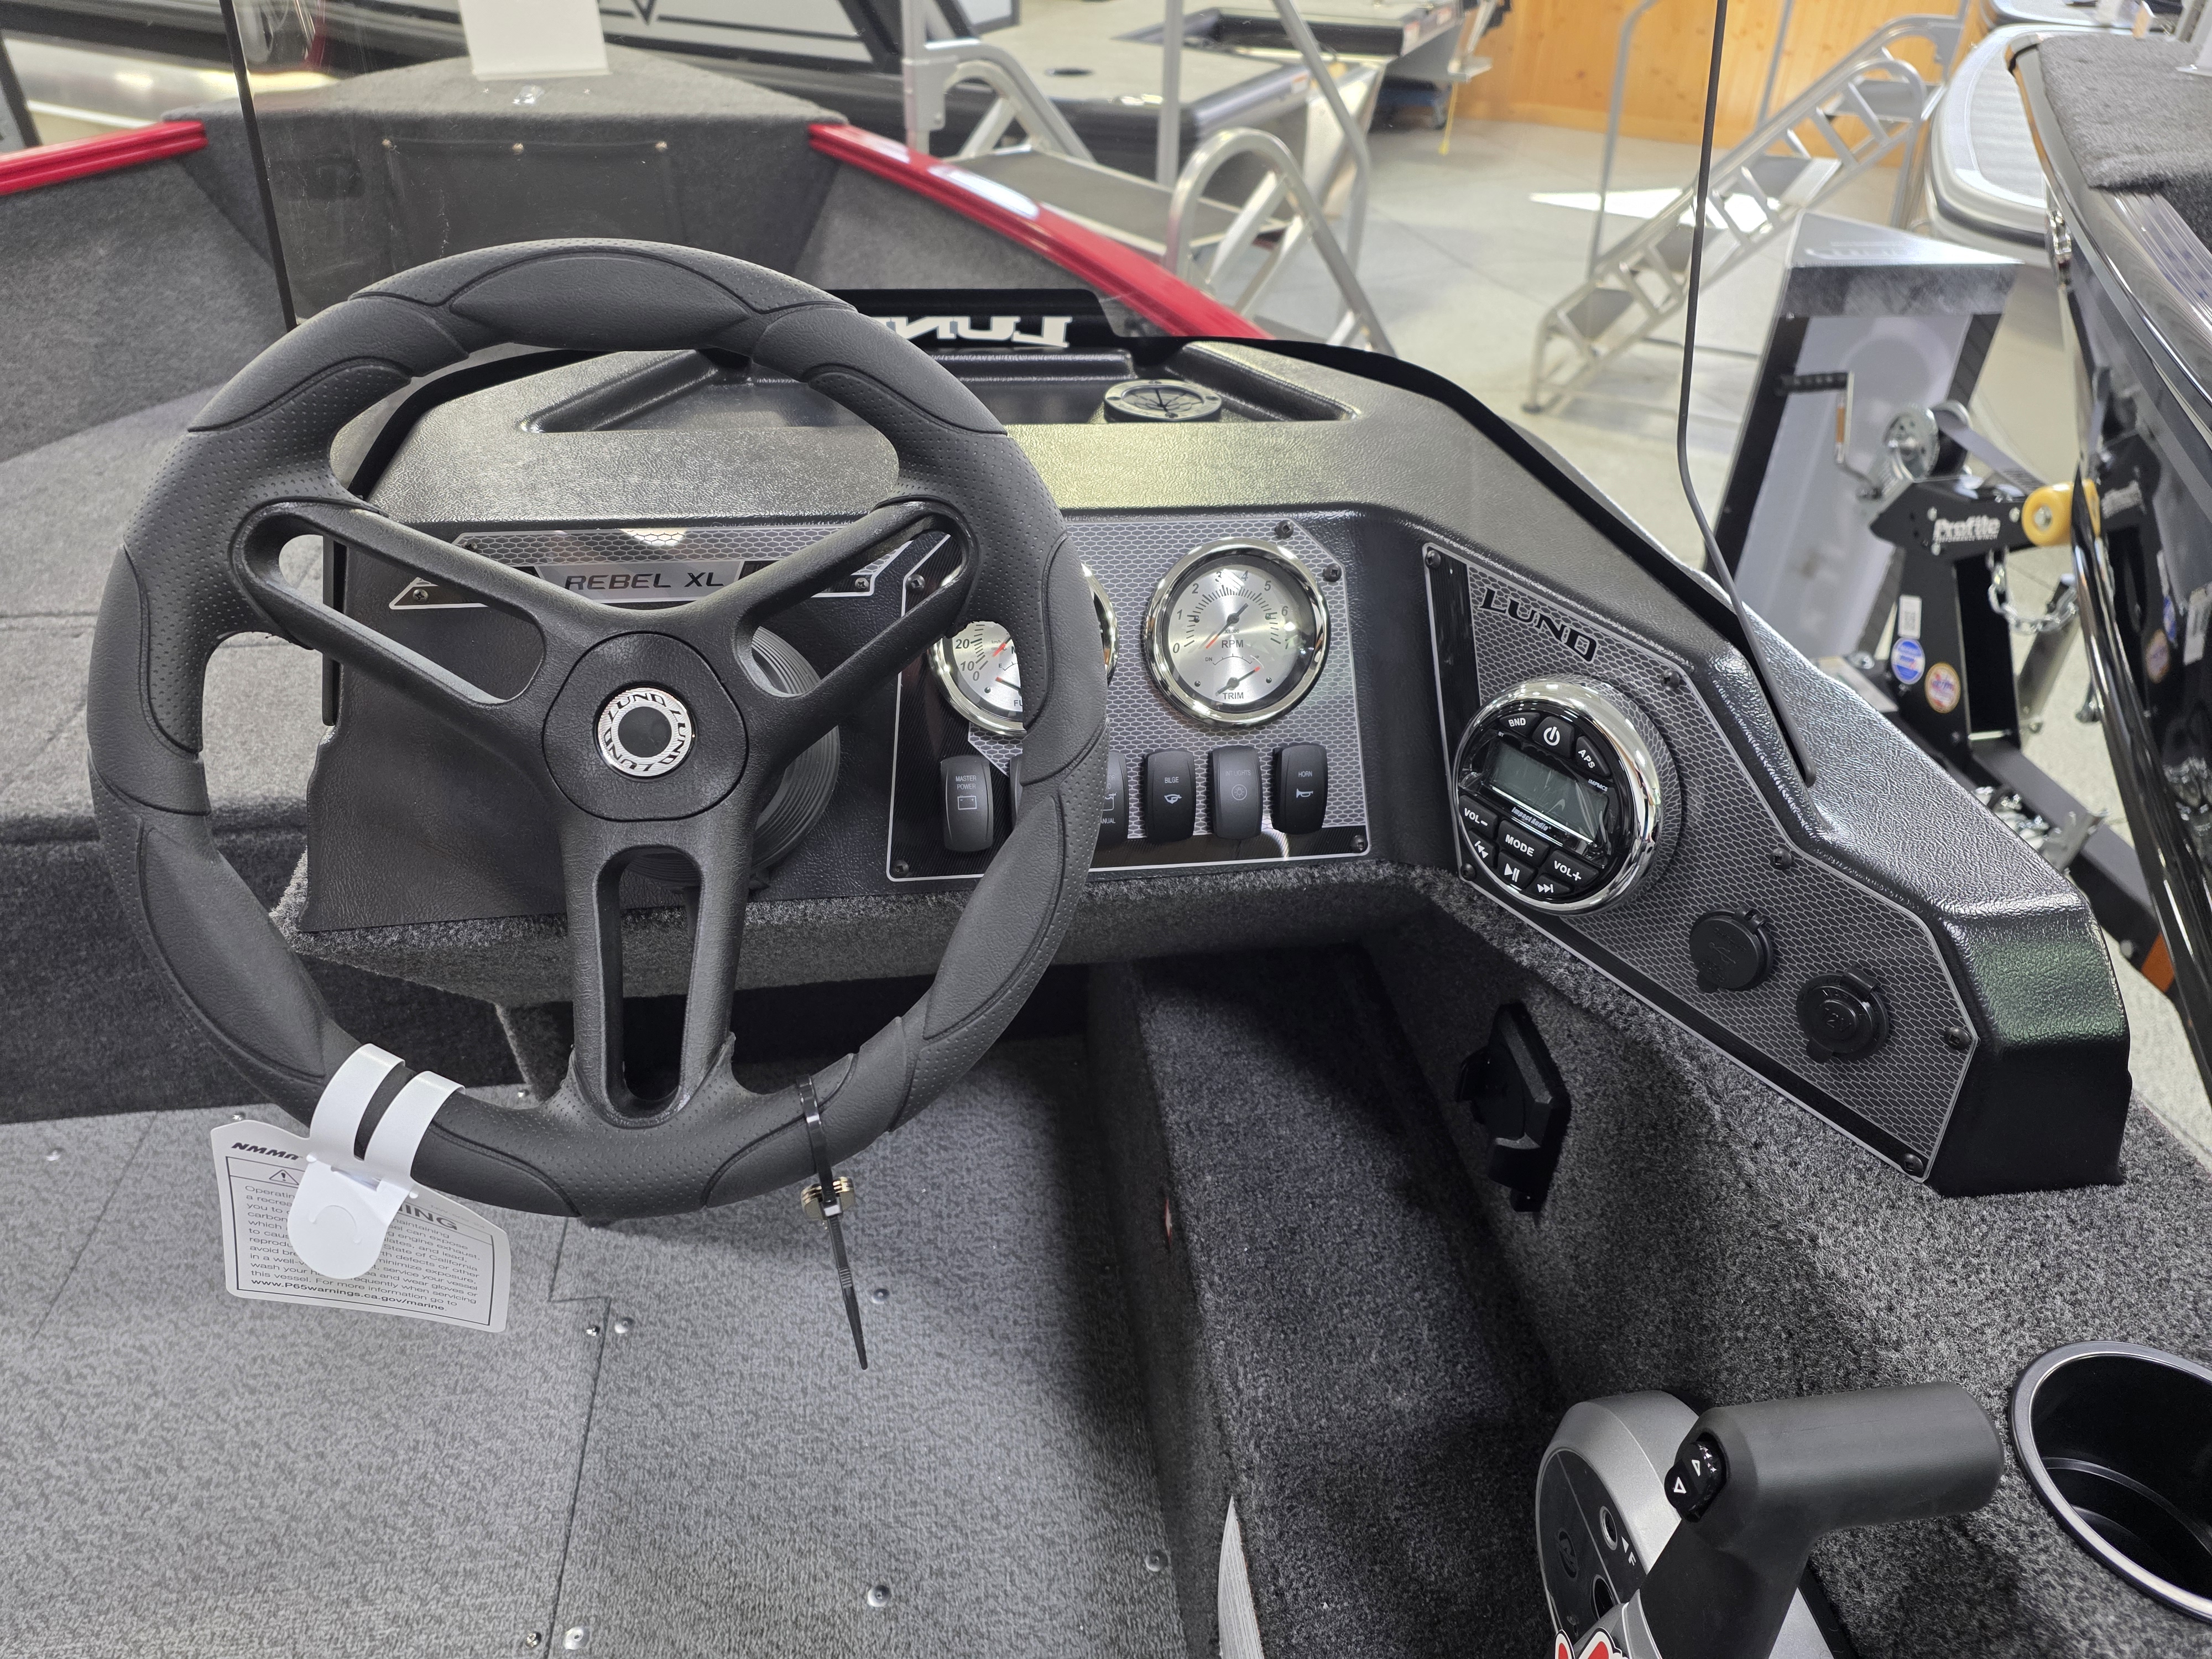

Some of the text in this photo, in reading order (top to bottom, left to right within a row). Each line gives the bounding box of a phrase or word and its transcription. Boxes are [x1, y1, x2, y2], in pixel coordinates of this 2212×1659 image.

[565, 572, 724, 590] REBEL XL
[1241, 570, 1248, 581] 4
[1192, 583, 1199, 594] 2
[1264, 580, 1271, 591] 5
[1176, 609, 1183, 620] 1
[1281, 606, 1288, 617] 6
[1480, 587, 1598, 662] LUND
[955, 639, 970, 649] 20
[1173, 643, 1180, 654] 0
[1222, 639, 1244, 648] RPM
[960, 661, 974, 671] 10
[972, 671, 980, 681] 0
[1222, 692, 1244, 700] TRIM
[608, 693, 667, 723] LUND
[1508, 717, 1526, 727] BND
[658, 709, 686, 764] LUND
[604, 727, 655, 772] LUND
[1578, 749, 1595, 769] APS
[1511, 807, 1532, 822] Impact
[1505, 834, 1535, 857] MODE
[245, 1185, 295, 1199] Operatin
[257, 1196, 293, 1207] recrea
[406, 1229, 426, 1238] can
[429, 1235, 468, 1250] expose
[247, 1212, 288, 1223] carbon
[419, 1246, 439, 1254] and
[398, 1234, 434, 1246] engine
[248, 1220, 281, 1229] which
[383, 1244, 412, 1255] State
[429, 1255, 478, 1271] California
[249, 1238, 293, 1248] reprodu
[264, 1231, 289, 1239] caus
[395, 1255, 435, 1267] defects
[452, 1268, 480, 1278] other
[249, 1245, 279, 1254] avoid
[383, 1267, 419, 1277] service
[446, 1280, 478, 1291] vessel
[274, 1273, 311, 1282] vessel.
[368, 1286, 427, 1300] information
[351, 1277, 399, 1288] equently
[401, 1285, 429, 1293] when
[432, 1291, 477, 1304] servicing
[431, 1284, 464, 1294] gloves
